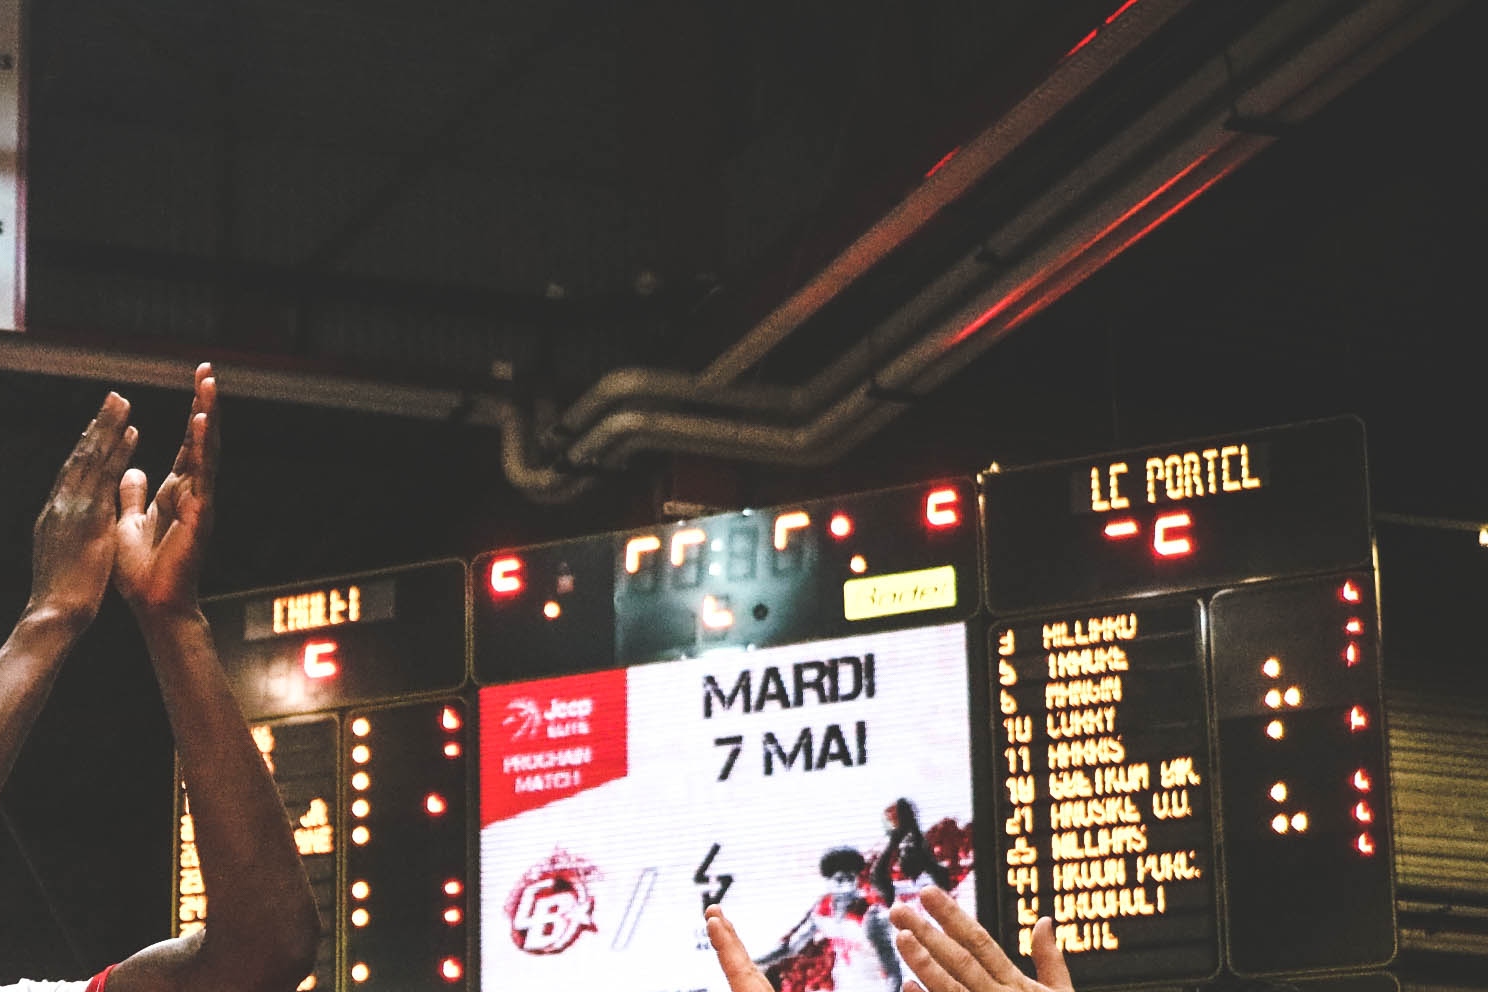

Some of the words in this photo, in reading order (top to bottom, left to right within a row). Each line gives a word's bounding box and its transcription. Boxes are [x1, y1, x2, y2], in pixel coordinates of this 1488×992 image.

[701, 652, 876, 719] MARDI
[515, 769, 581, 793] MATCH
[714, 734, 744, 783] 7
[762, 720, 869, 777] MAI
